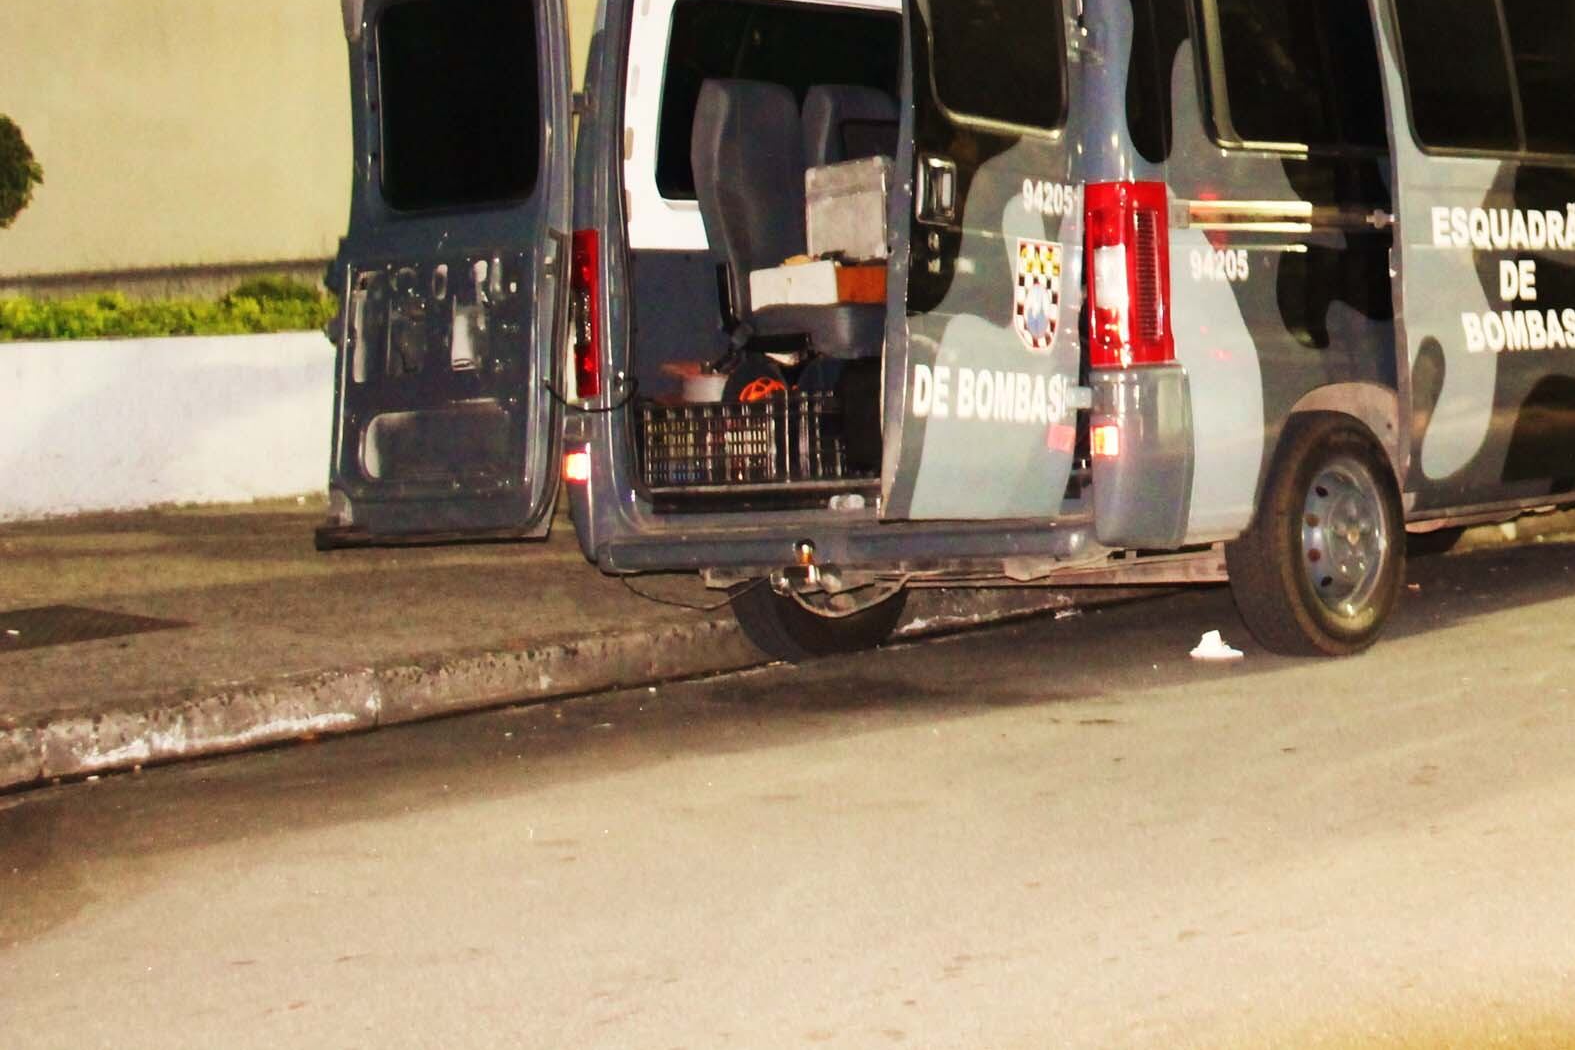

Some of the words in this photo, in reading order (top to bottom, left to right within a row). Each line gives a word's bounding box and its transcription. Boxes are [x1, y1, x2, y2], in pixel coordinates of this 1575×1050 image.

[1022, 178, 1074, 217] 94205
[1190, 248, 1249, 282] 94205
[1499, 259, 1538, 302] DE
[912, 363, 951, 418] DE
[956, 367, 1064, 425] BOMBAS
